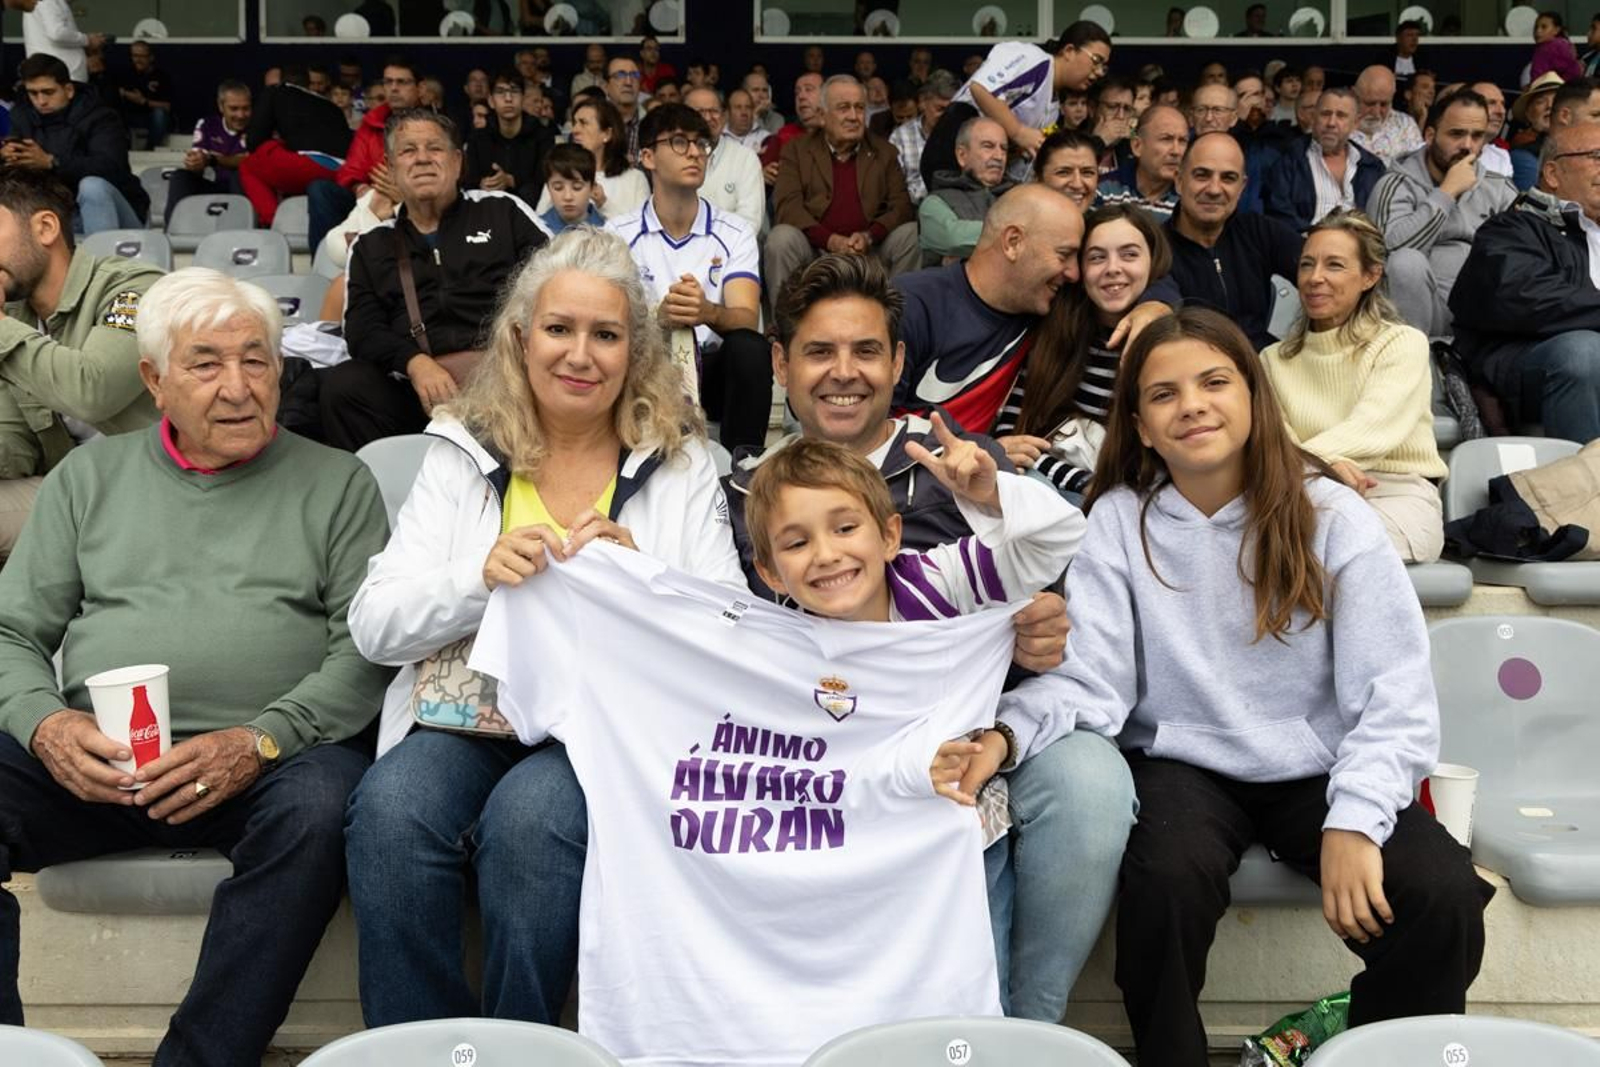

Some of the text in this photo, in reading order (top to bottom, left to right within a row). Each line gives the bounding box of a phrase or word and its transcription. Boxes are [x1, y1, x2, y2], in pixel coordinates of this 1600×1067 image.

[711, 713, 828, 762] ÁNIMO
[670, 743, 847, 804] ÁLVARO
[670, 794, 845, 854] DURÁN
[454, 1048, 474, 1064] 059
[949, 1044, 968, 1060] 057
[1446, 1048, 1466, 1064] 055
